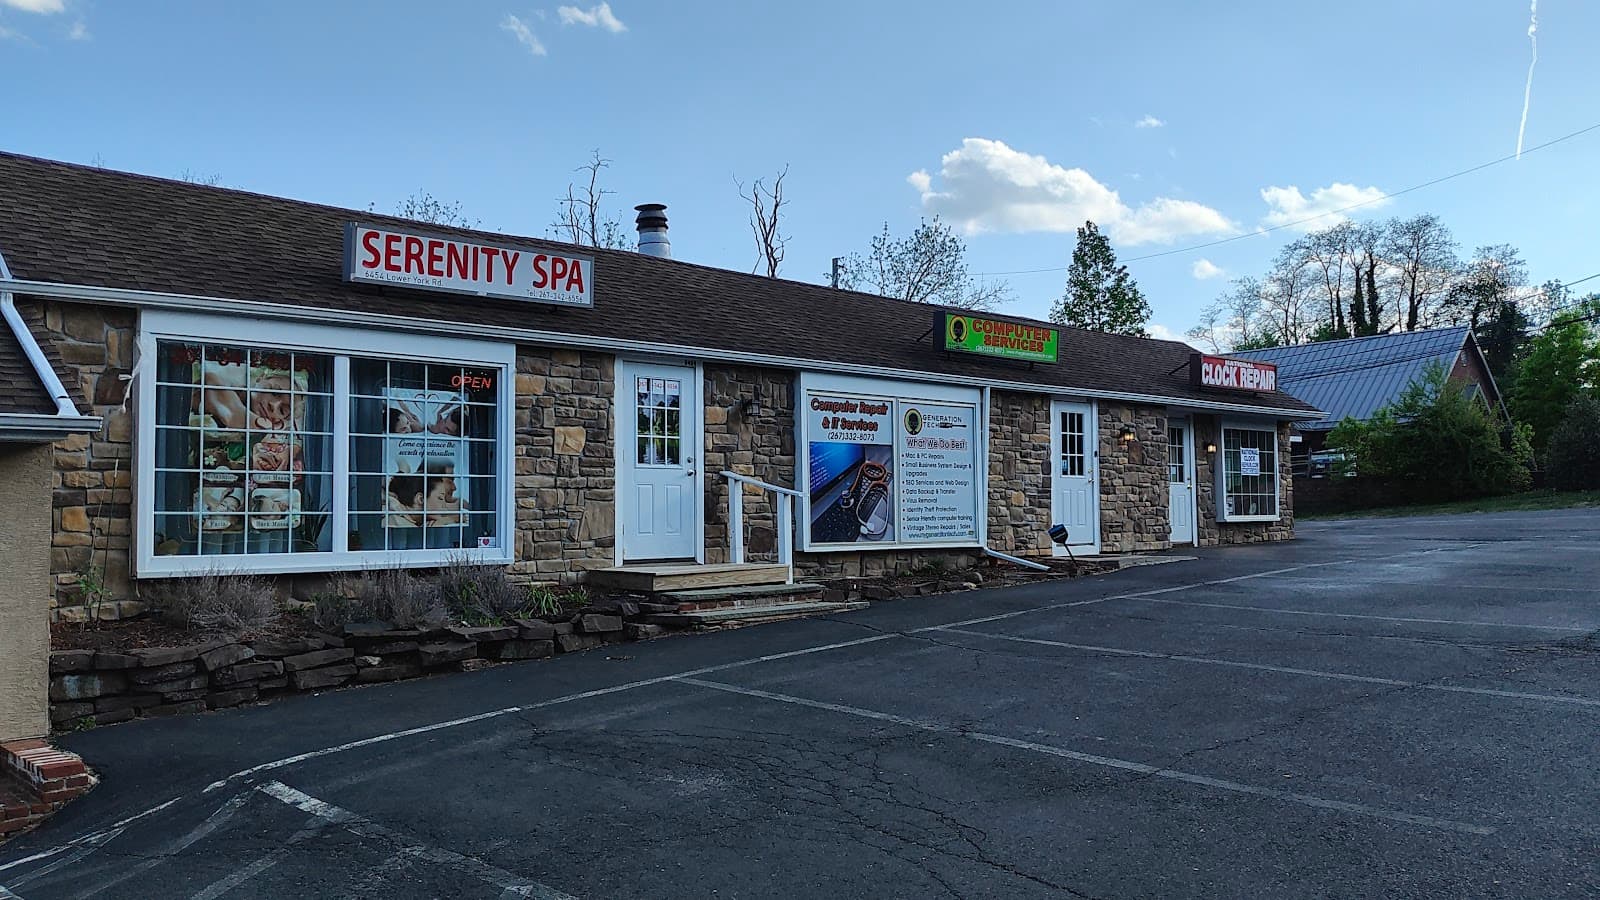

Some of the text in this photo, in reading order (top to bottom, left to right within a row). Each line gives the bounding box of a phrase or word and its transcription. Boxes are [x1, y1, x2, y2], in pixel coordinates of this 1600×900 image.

[362, 231, 584, 294] SERENITY SPA
[365, 270, 443, 286] 6454 Lower York Rd.
[972, 319, 1051, 342] COMPUTER
[984, 334, 1044, 352] SERVICES
[451, 376, 491, 389] OPEN
[1201, 363, 1276, 391] CLOCK REPAIR
[811, 398, 888, 416] Computer Repair
[822, 416, 878, 431] & IT Services
[398, 439, 415, 448] Come
[907, 439, 926, 448] What
[927, 440, 938, 449] We
[940, 440, 950, 449] Do
[398, 449, 417, 457] secrets
[938, 462, 953, 470] System
